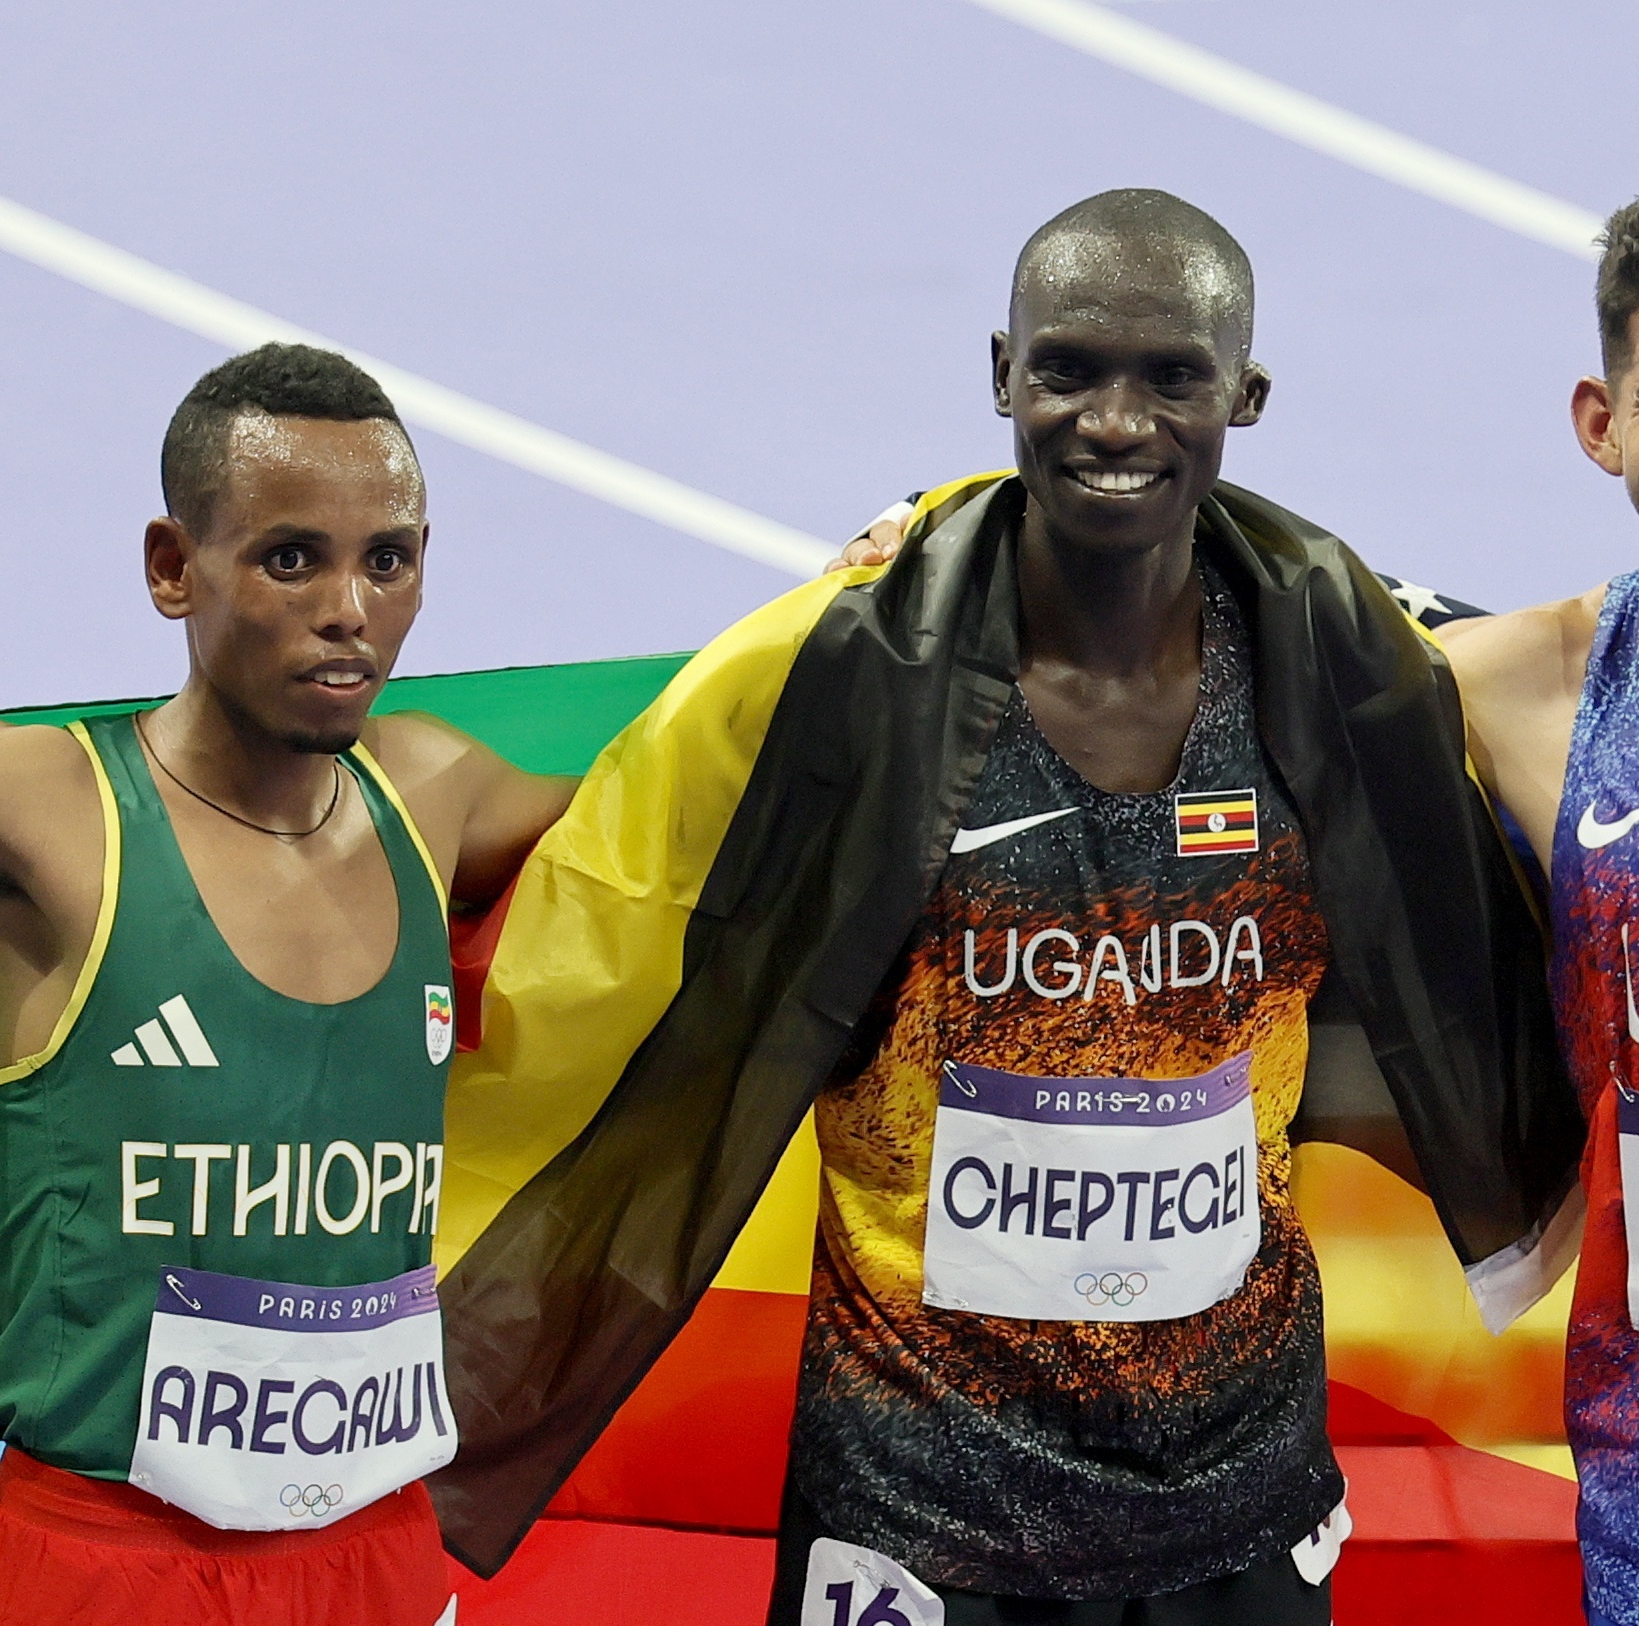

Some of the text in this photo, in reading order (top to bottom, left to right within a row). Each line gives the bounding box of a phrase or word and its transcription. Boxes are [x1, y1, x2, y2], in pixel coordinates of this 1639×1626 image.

[963, 915, 1264, 1006] UGANDA
[1135, 1088, 1208, 1114] 2024
[942, 1144, 1245, 1242] CHEPTEGEI
[349, 1291, 398, 1319] 2024
[146, 1361, 449, 1456] AREGAWI
